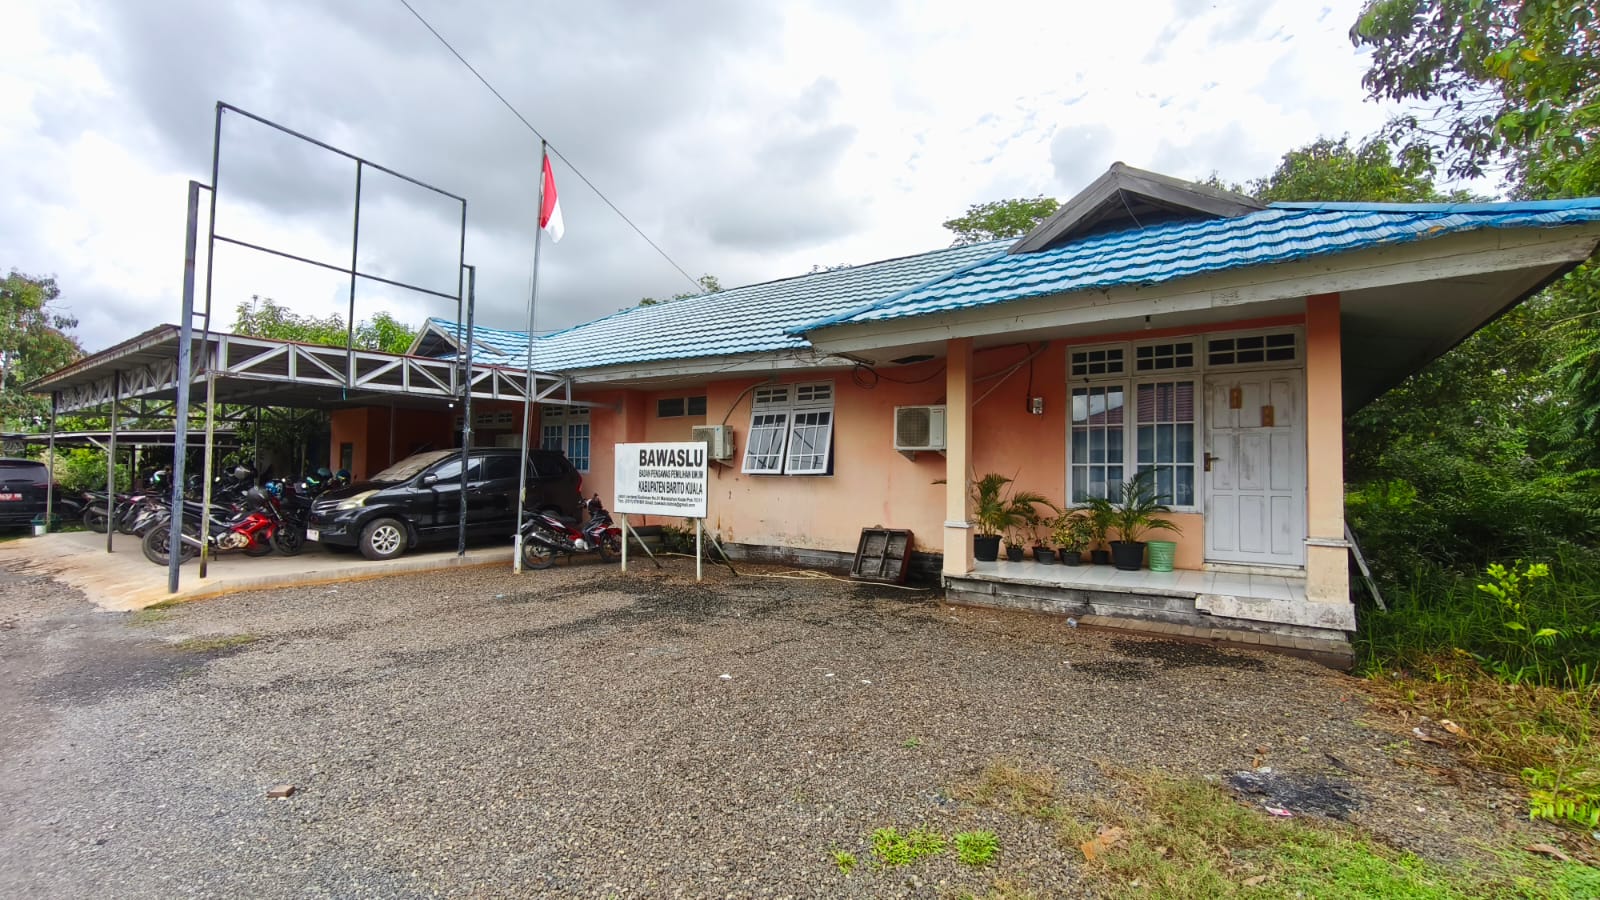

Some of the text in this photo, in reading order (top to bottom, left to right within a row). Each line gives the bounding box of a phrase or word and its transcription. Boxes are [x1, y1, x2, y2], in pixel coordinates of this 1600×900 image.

[639, 449, 703, 467] BAWASLU
[638, 480, 703, 496] KABUPATEN BARITO KUALA
